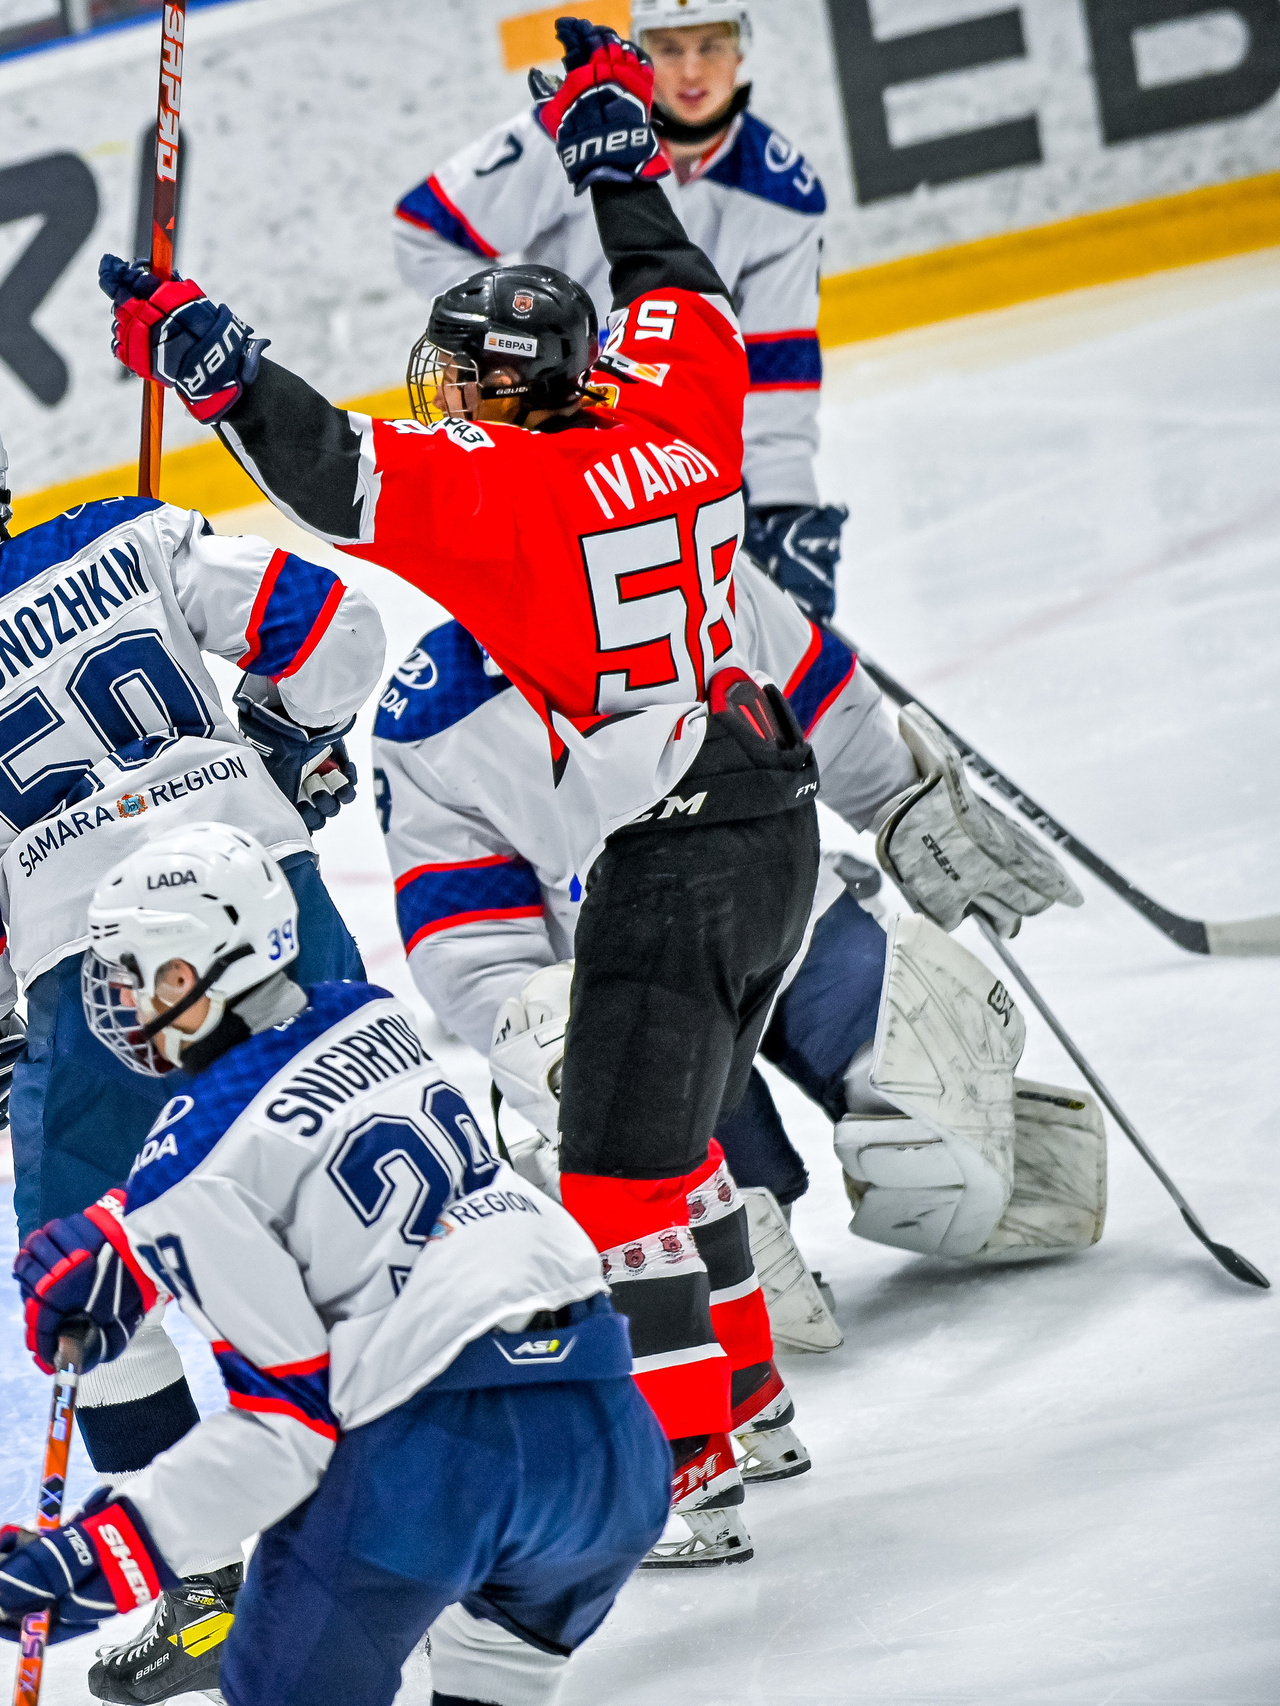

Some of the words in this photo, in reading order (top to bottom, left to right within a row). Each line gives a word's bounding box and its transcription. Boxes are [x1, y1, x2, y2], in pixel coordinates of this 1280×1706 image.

[497, 338, 533, 352] ЕВРАЗ
[442, 416, 485, 444] РАЗ
[577, 486, 746, 716] 58
[379, 686, 409, 721] DA
[18, 804, 116, 879] SAMARA
[148, 754, 249, 808] REGION
[146, 869, 198, 891] LADA
[266, 917, 295, 961] 39
[447, 1189, 542, 1226] REGION
[135, 1652, 171, 1681] BAUER
